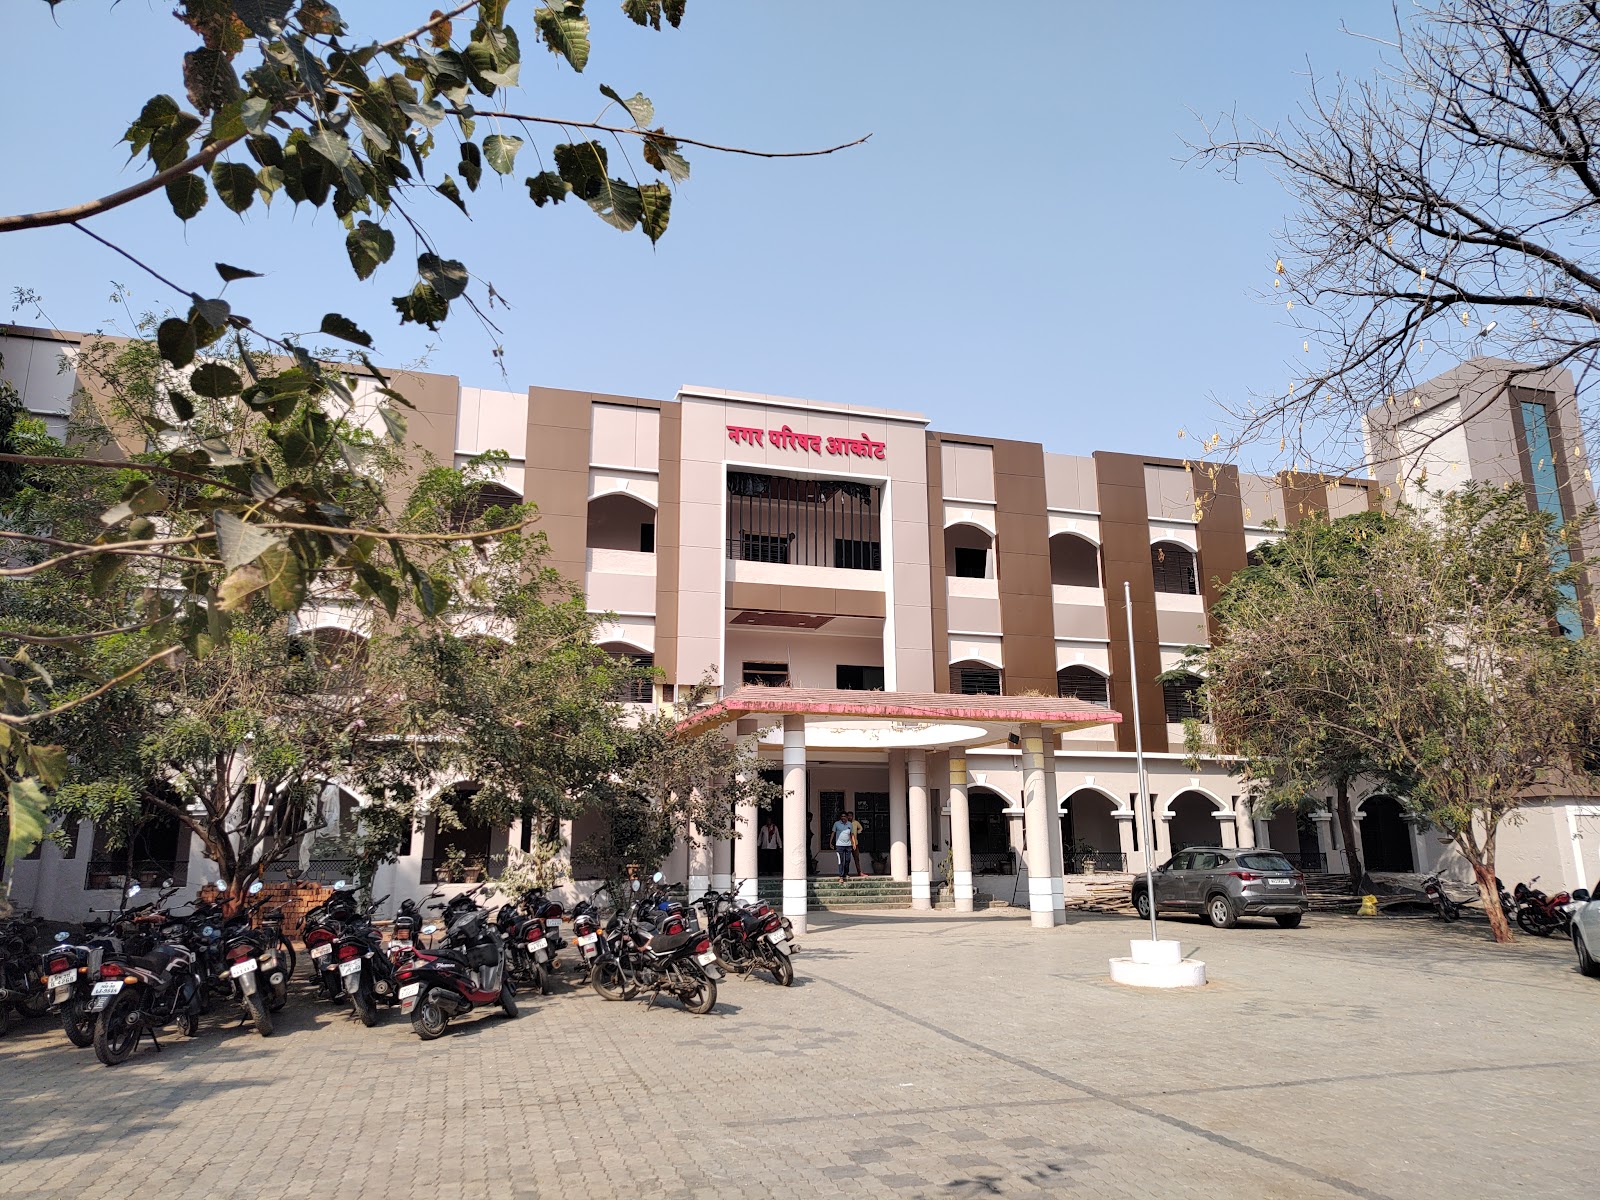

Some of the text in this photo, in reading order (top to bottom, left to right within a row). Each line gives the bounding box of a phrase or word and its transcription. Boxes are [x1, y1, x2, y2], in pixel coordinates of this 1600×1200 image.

[726, 425, 886, 460] नगर परिषद आकोट
